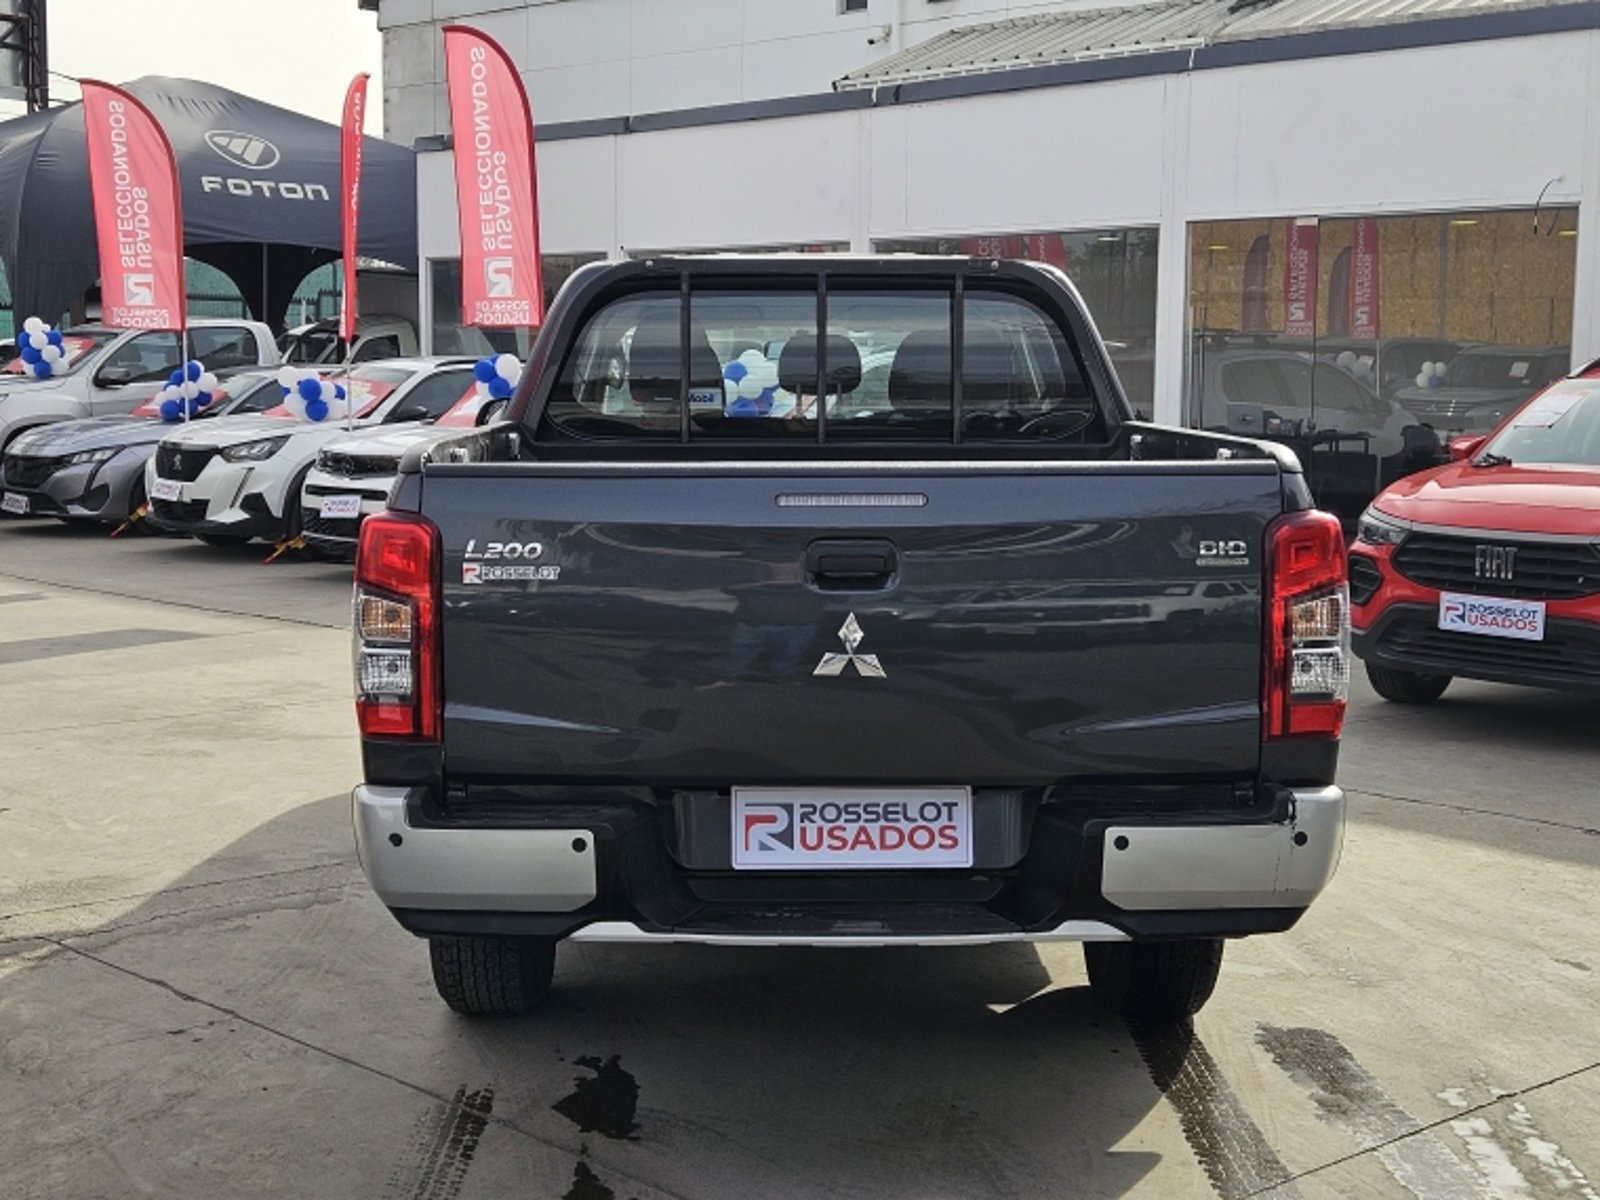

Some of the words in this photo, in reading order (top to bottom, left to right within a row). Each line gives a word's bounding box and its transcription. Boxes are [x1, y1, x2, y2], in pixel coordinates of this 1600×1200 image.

[201, 176, 329, 201] FOTON
[464, 539, 543, 559] L200
[1475, 544, 1518, 580] FIAT
[1467, 603, 1539, 620] ROSSELOT
[1467, 614, 1538, 633] USADOS
[800, 802, 958, 823] ROSSELOT
[800, 824, 959, 851] USADOS
